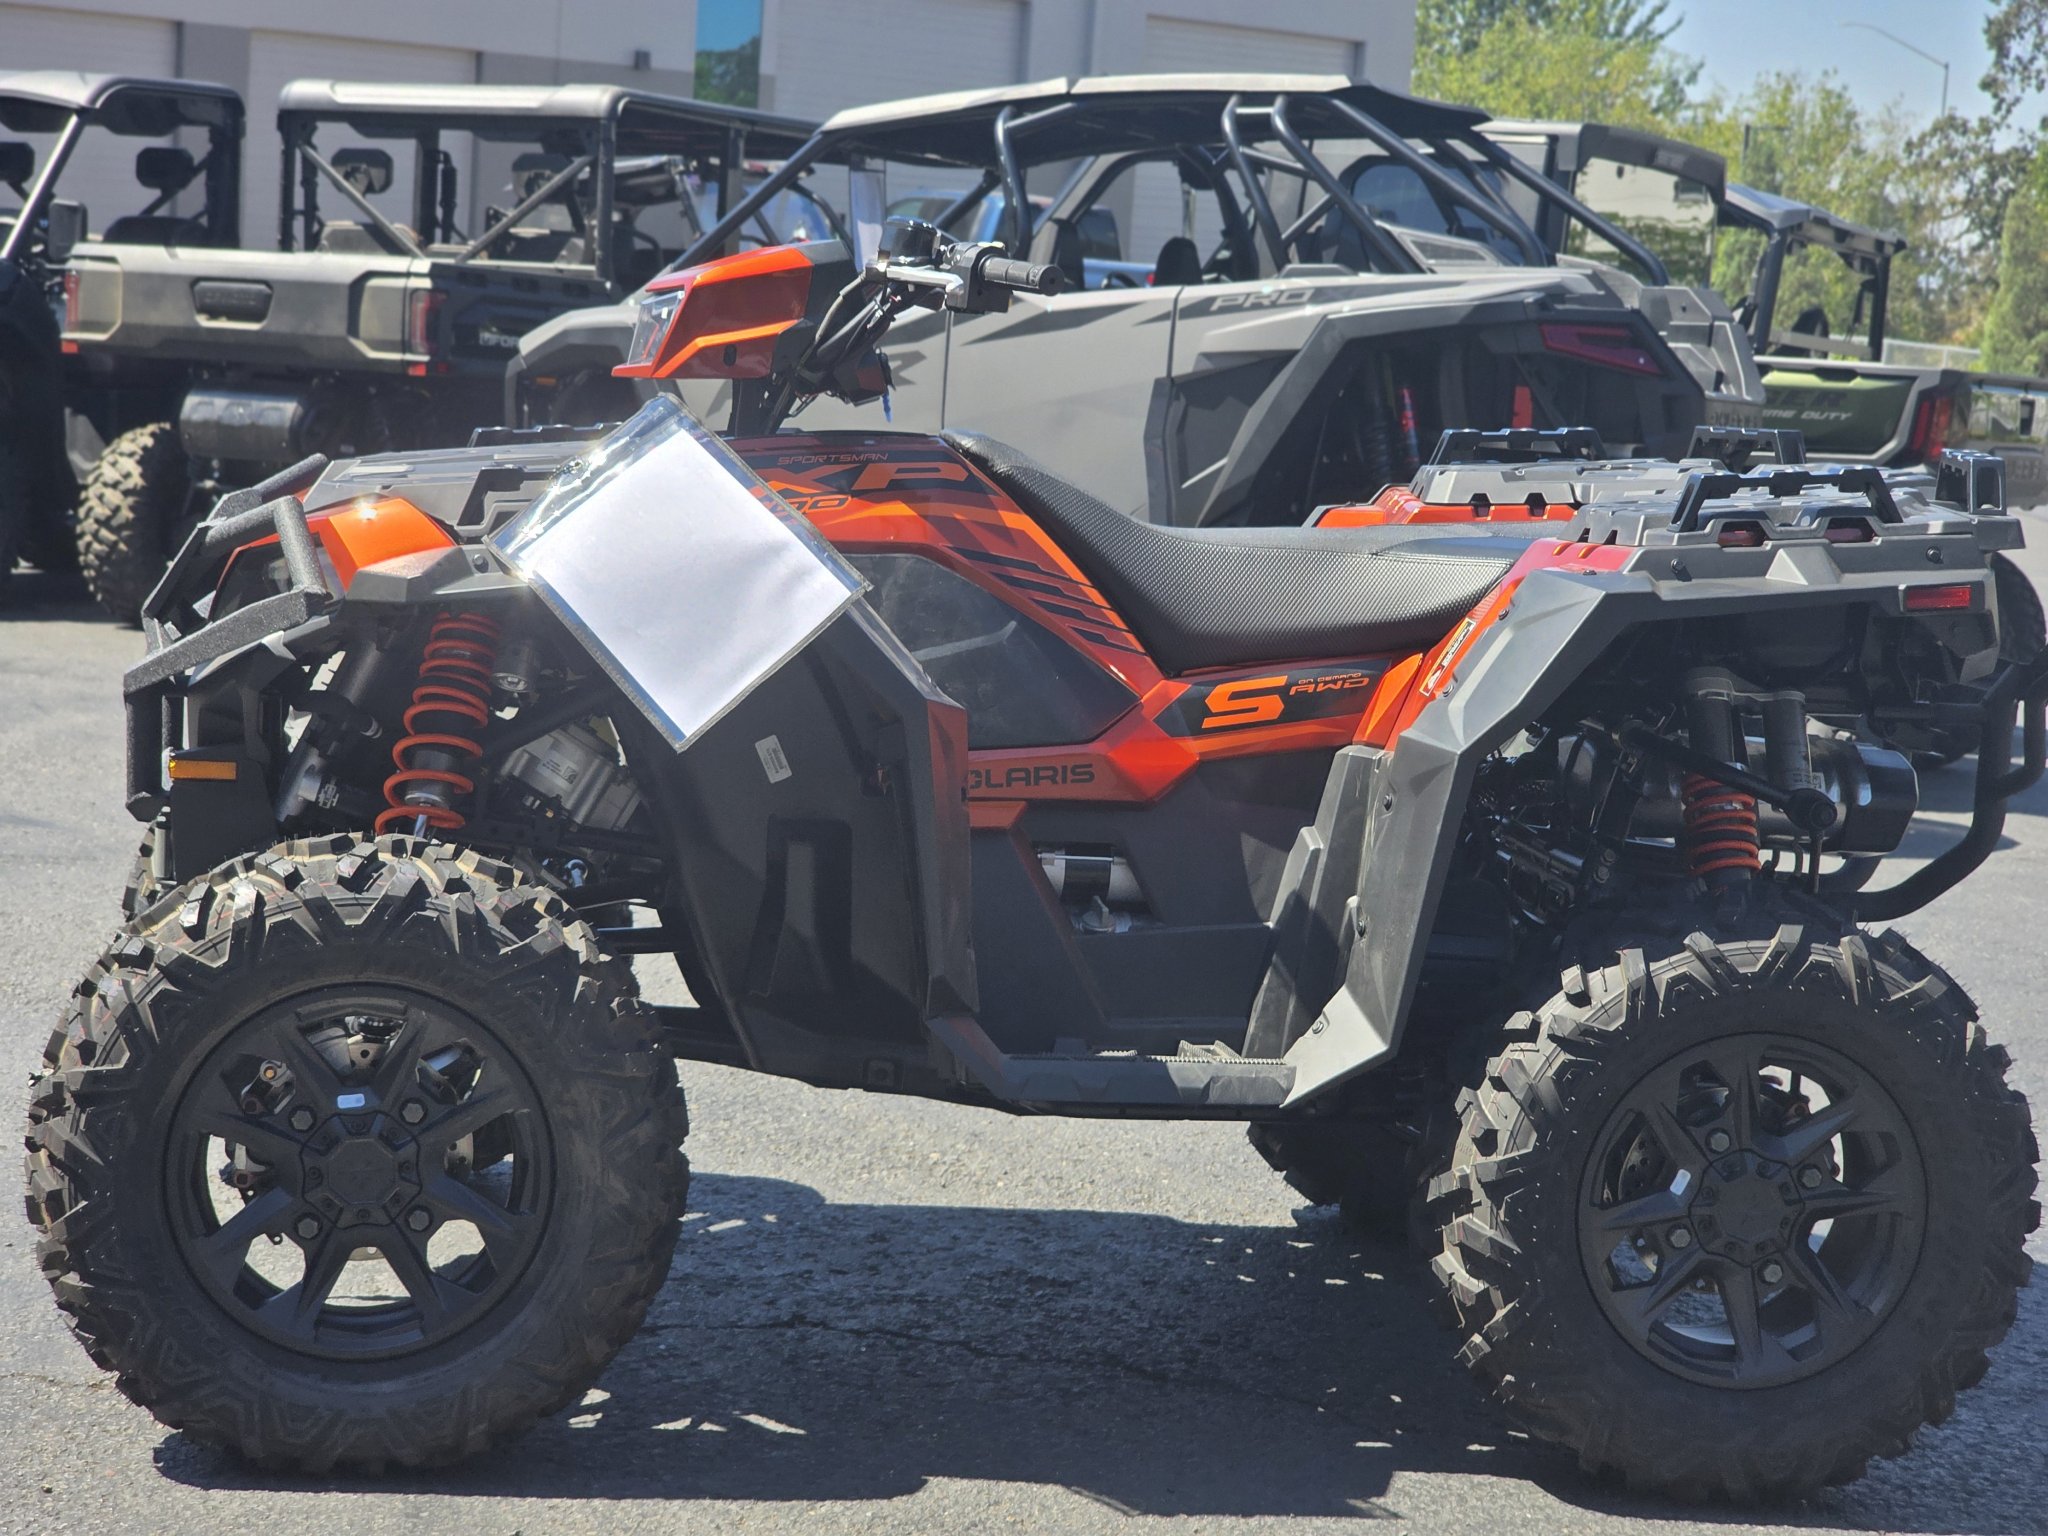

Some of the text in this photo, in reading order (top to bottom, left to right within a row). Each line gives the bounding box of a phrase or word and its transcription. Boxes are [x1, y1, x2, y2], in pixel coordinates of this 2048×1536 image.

[1209, 288, 1315, 312] PRO
[1800, 410, 1853, 421] DUTY
[777, 452, 889, 466] SPORTSMAN
[755, 461, 969, 493] XP
[1289, 677, 1370, 696] AWD
[1317, 672, 1362, 682] DEMAND
[1201, 675, 1288, 729] S
[968, 763, 1096, 789] OLARIS
